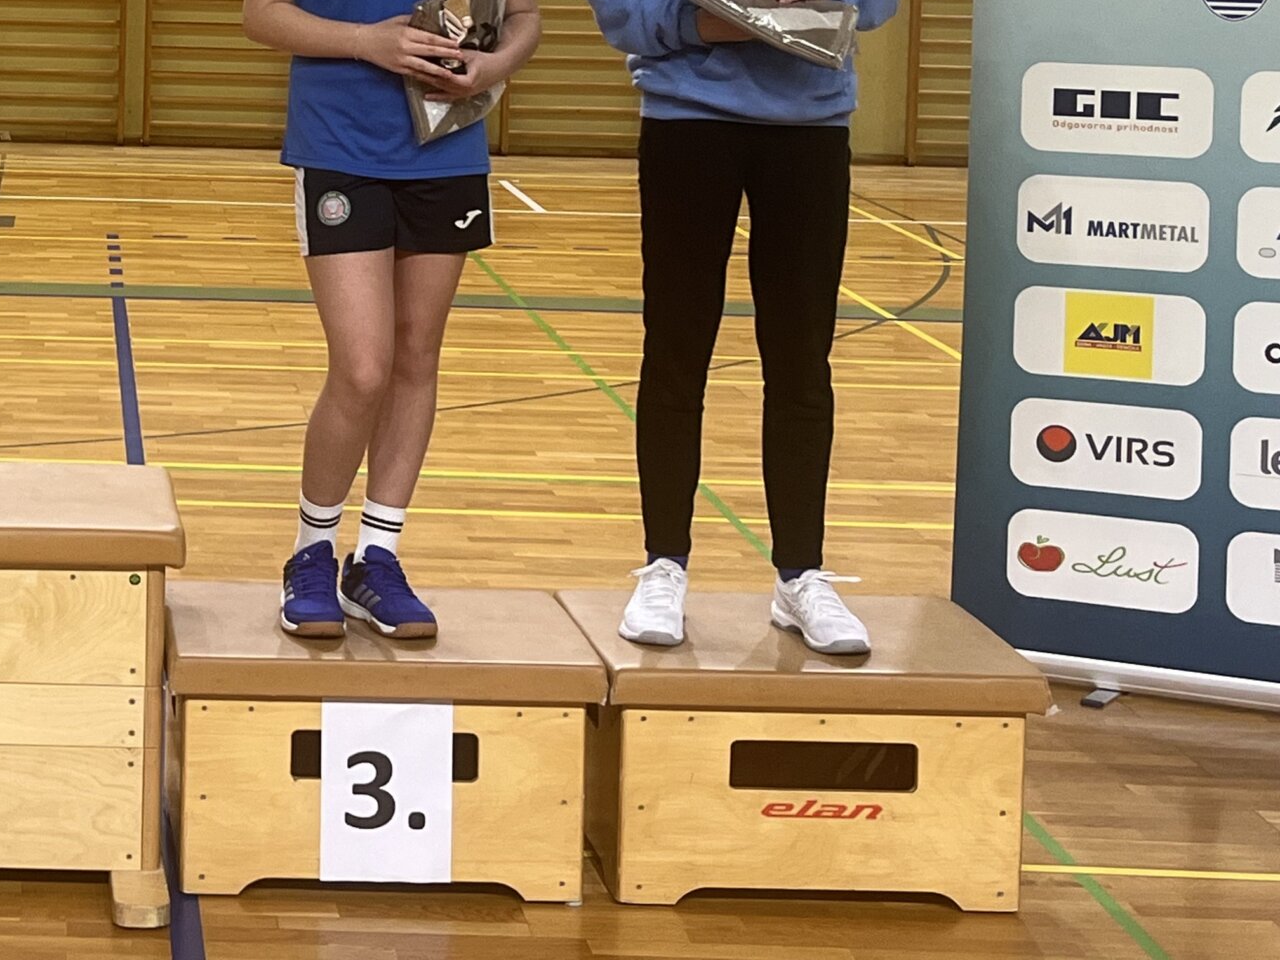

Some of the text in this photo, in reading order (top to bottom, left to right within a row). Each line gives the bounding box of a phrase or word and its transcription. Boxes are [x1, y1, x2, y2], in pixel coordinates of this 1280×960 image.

[1052, 119, 1179, 133] Odgovorna prihodnost
[1087, 220, 1199, 243] MARTMETAL
[1085, 433, 1175, 467] VIRS
[345, 751, 426, 830] 3.
[761, 800, 883, 820] elan
